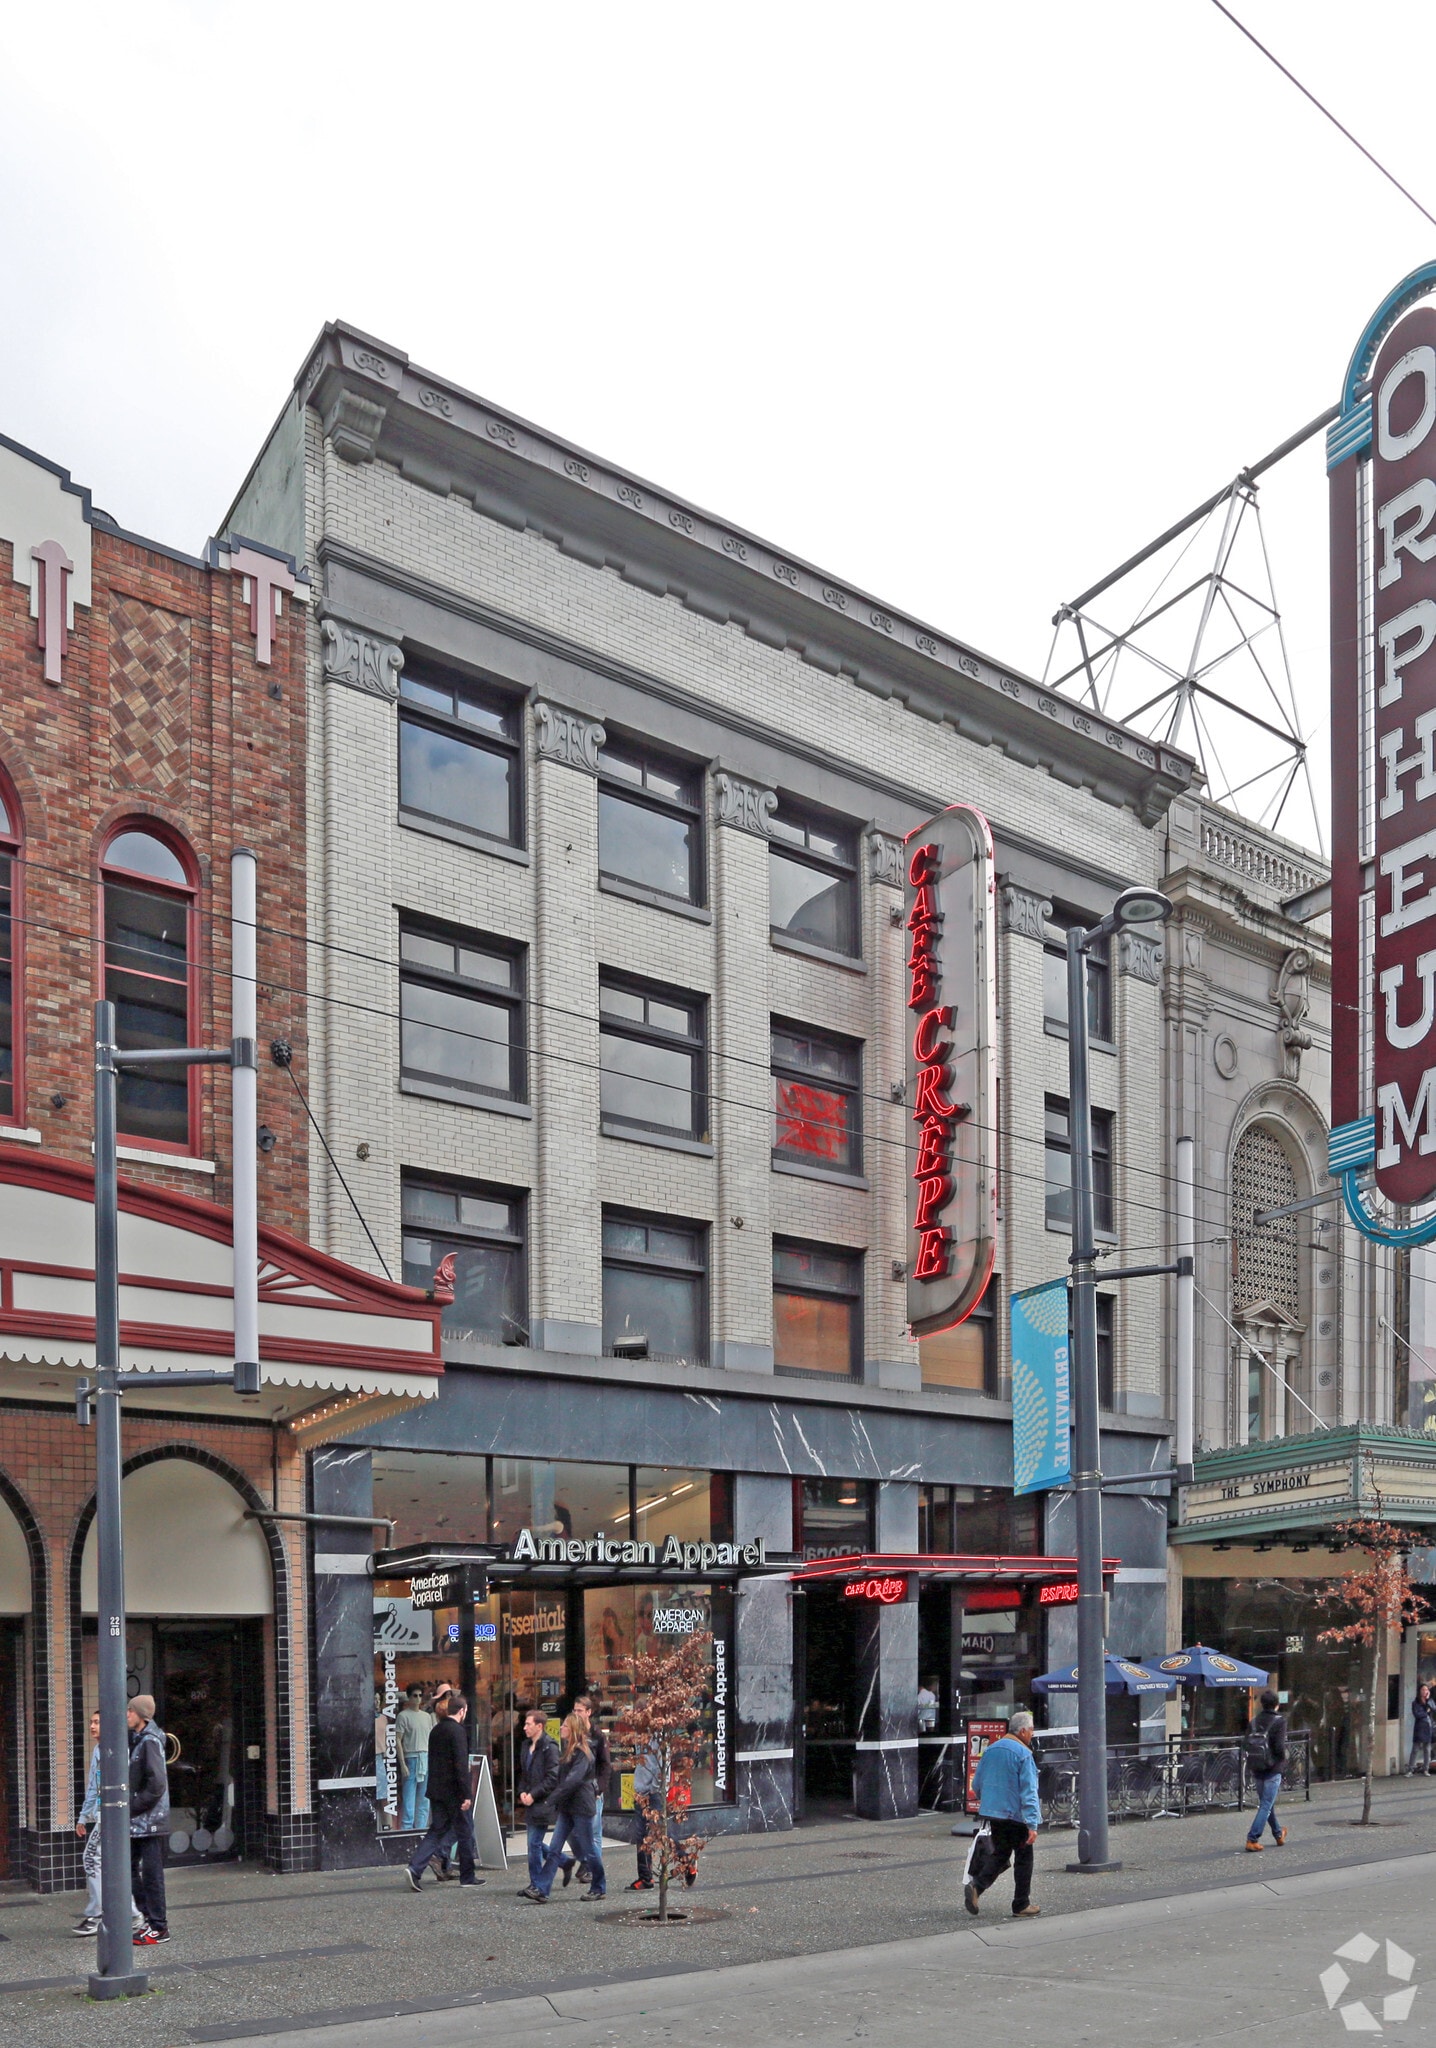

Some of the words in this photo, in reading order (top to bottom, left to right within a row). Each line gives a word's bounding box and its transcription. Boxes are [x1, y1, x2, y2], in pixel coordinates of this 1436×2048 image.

[1378, 345, 1436, 1169] ORPHEUM
[911, 1005, 963, 1279] CRÊPE
[1221, 1486, 1240, 1500] THE
[1253, 1474, 1310, 1495] SYMPHONY
[513, 1528, 656, 1563] American
[661, 1534, 766, 1570] Apparel
[410, 1572, 449, 1592] American
[845, 1582, 866, 1596] CAFÉ
[866, 1579, 903, 1603] CRÊPE
[410, 1587, 443, 1607] Apparel
[109, 1616, 120, 1625] 22
[502, 1604, 566, 1636] Essentials
[653, 1608, 704, 1622] AMERICAN
[653, 1620, 694, 1633] APPAREL
[110, 1627, 120, 1636] 08
[448, 1623, 496, 1637] CSIO
[542, 1642, 561, 1652] 872
[713, 1638, 728, 1706] Apparel
[714, 1709, 727, 1790] American
[384, 1723, 399, 1817] American
